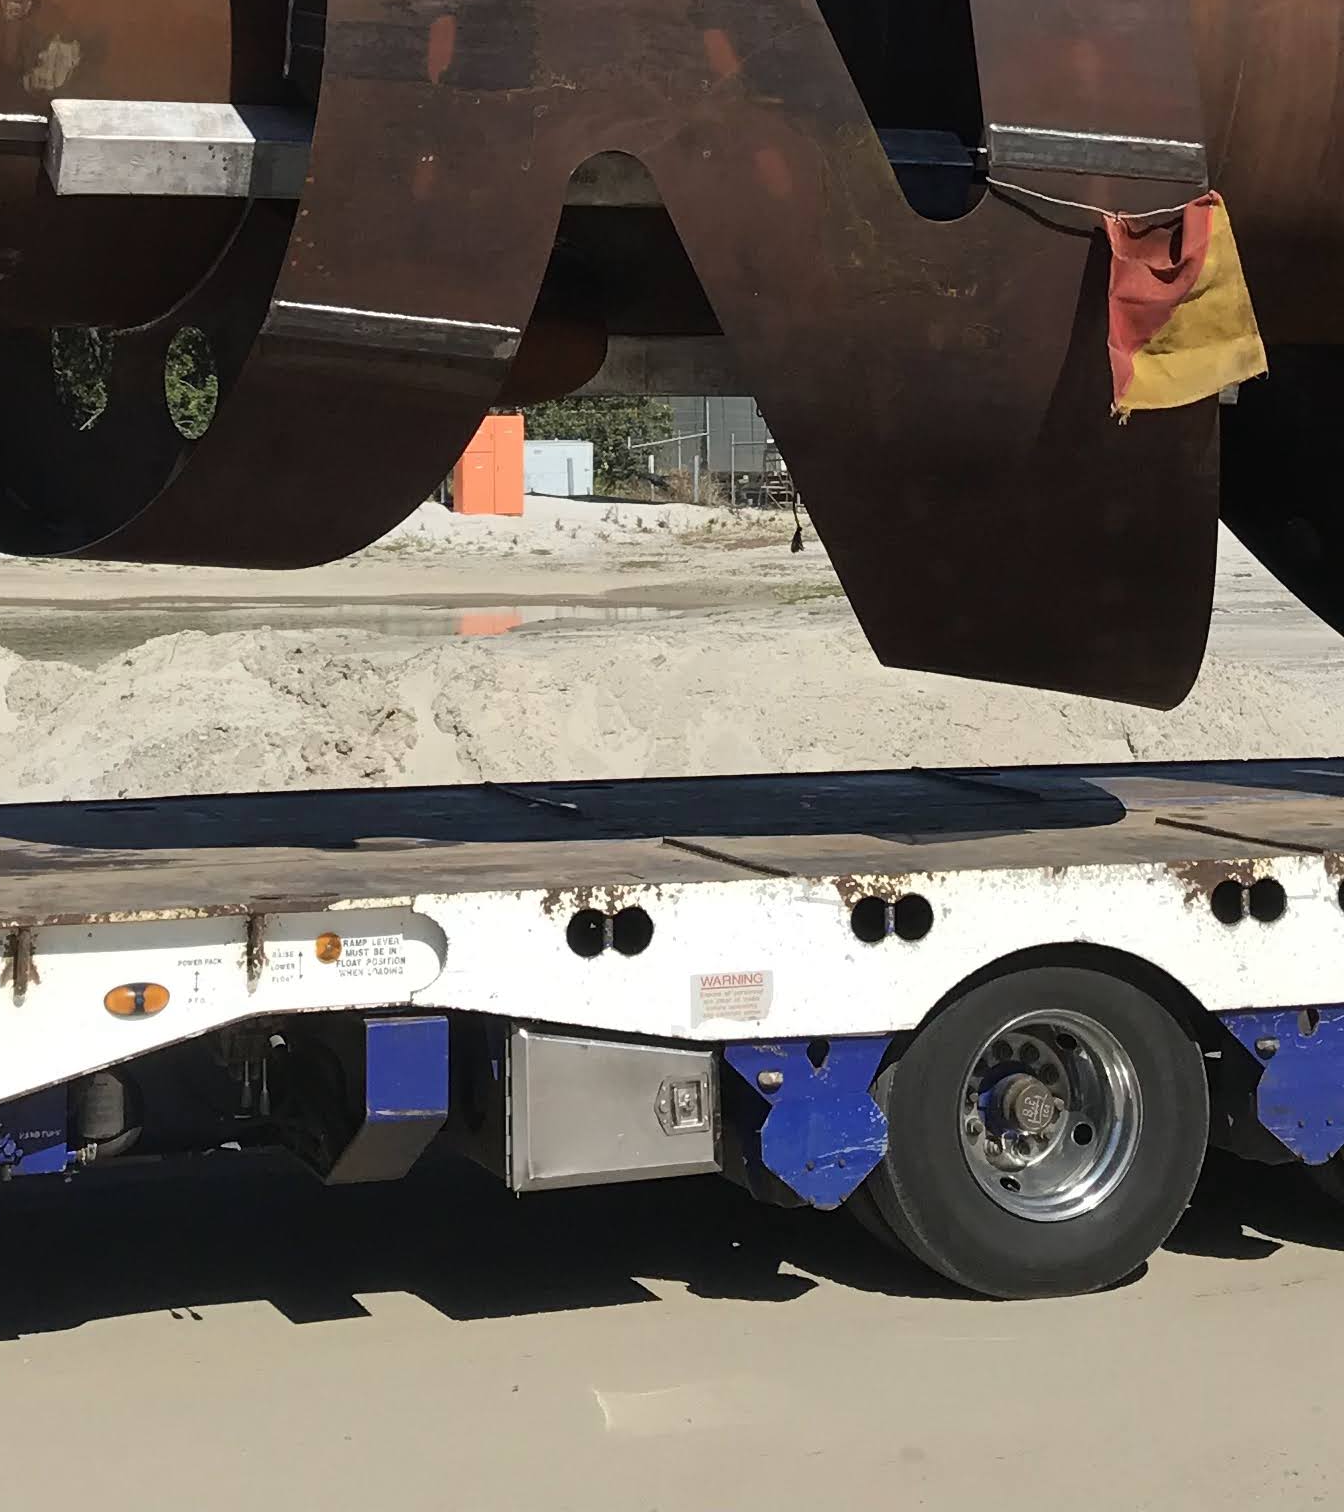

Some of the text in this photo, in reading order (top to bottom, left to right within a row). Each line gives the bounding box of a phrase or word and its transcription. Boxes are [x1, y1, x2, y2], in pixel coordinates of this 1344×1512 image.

[343, 937, 399, 947] RAMP LEVER
[345, 947, 397, 957] MUST BE IN
[178, 959, 203, 967] POWER
[336, 957, 406, 968] FLOAT POSITION
[339, 968, 364, 977] WHEN
[700, 972, 764, 987] WARNING
